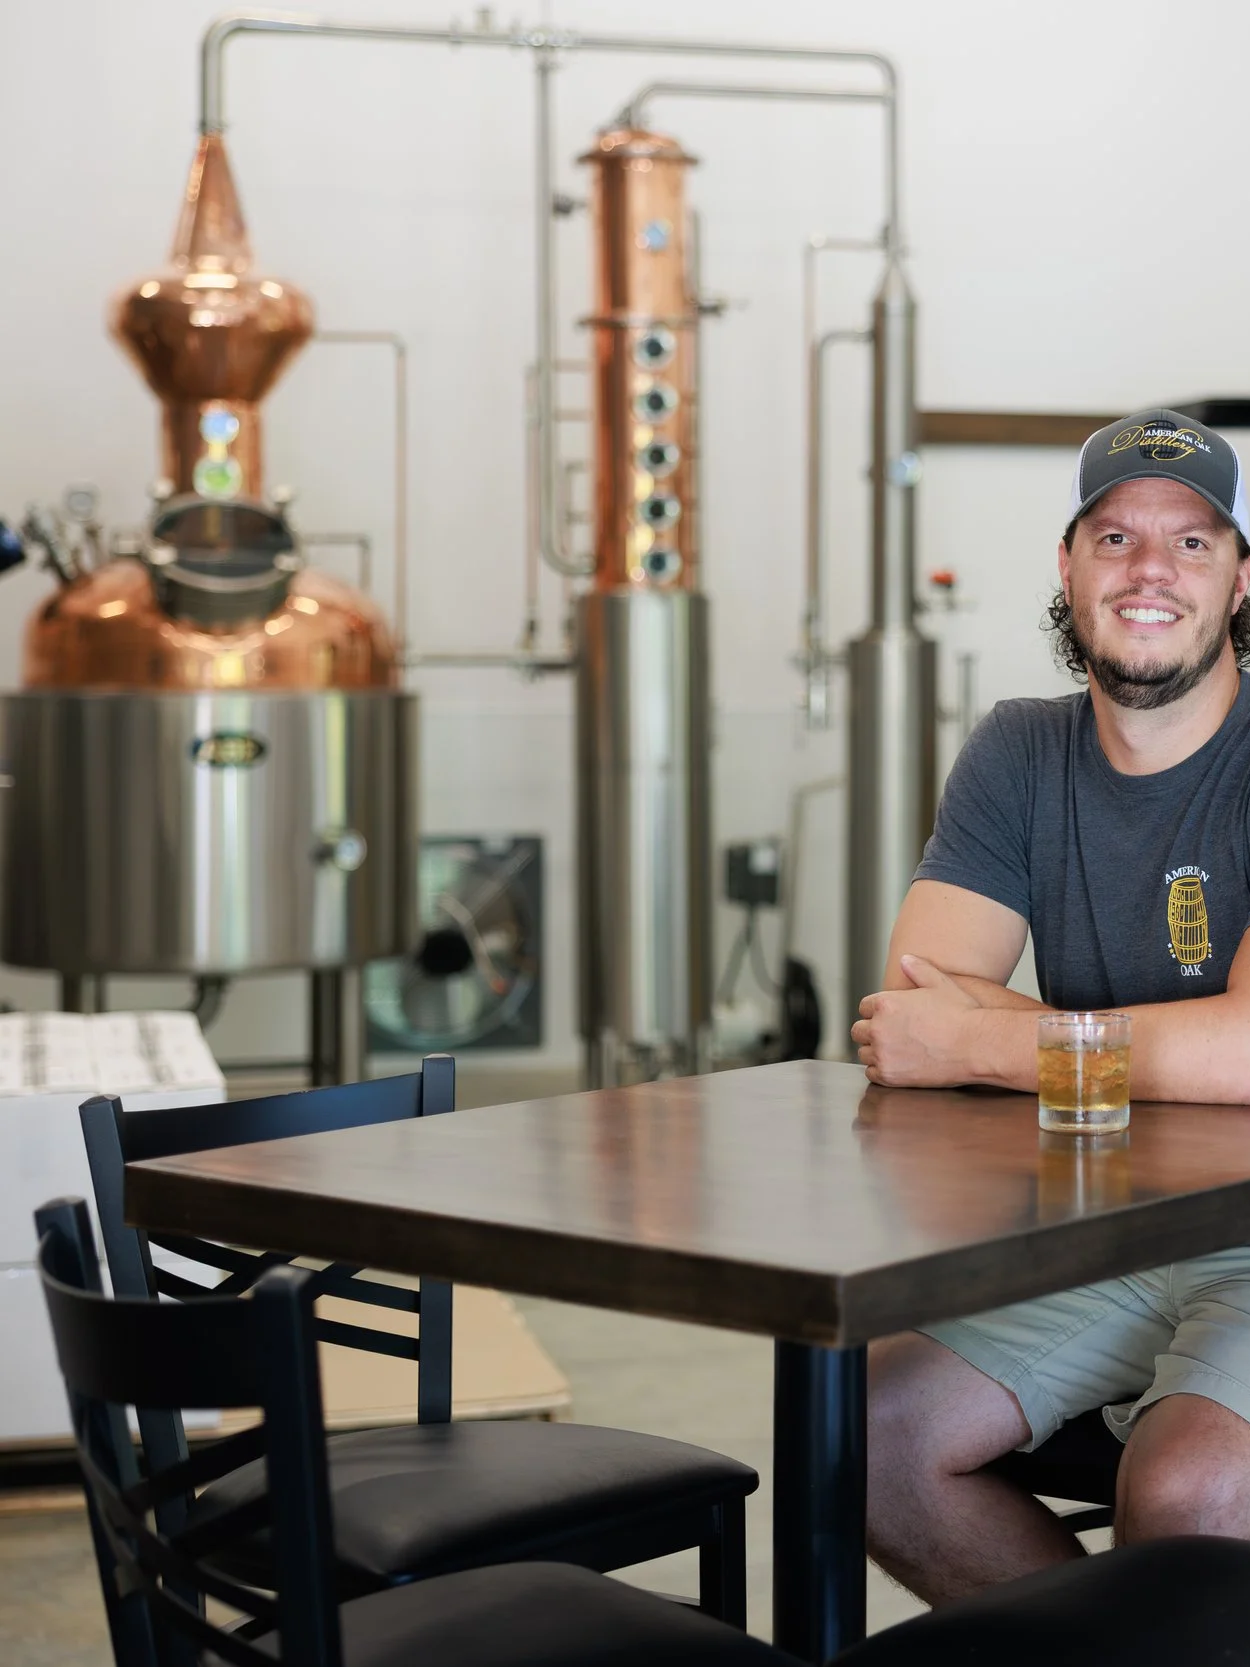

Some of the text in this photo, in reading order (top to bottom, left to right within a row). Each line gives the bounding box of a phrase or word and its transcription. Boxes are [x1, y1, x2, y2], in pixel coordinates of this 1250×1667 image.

[1108, 423, 1203, 460] Distillery
[1145, 429, 1212, 453] AMERICAN OAK
[1165, 866, 1210, 885] AMERICN
[1180, 964, 1203, 976] OAK
